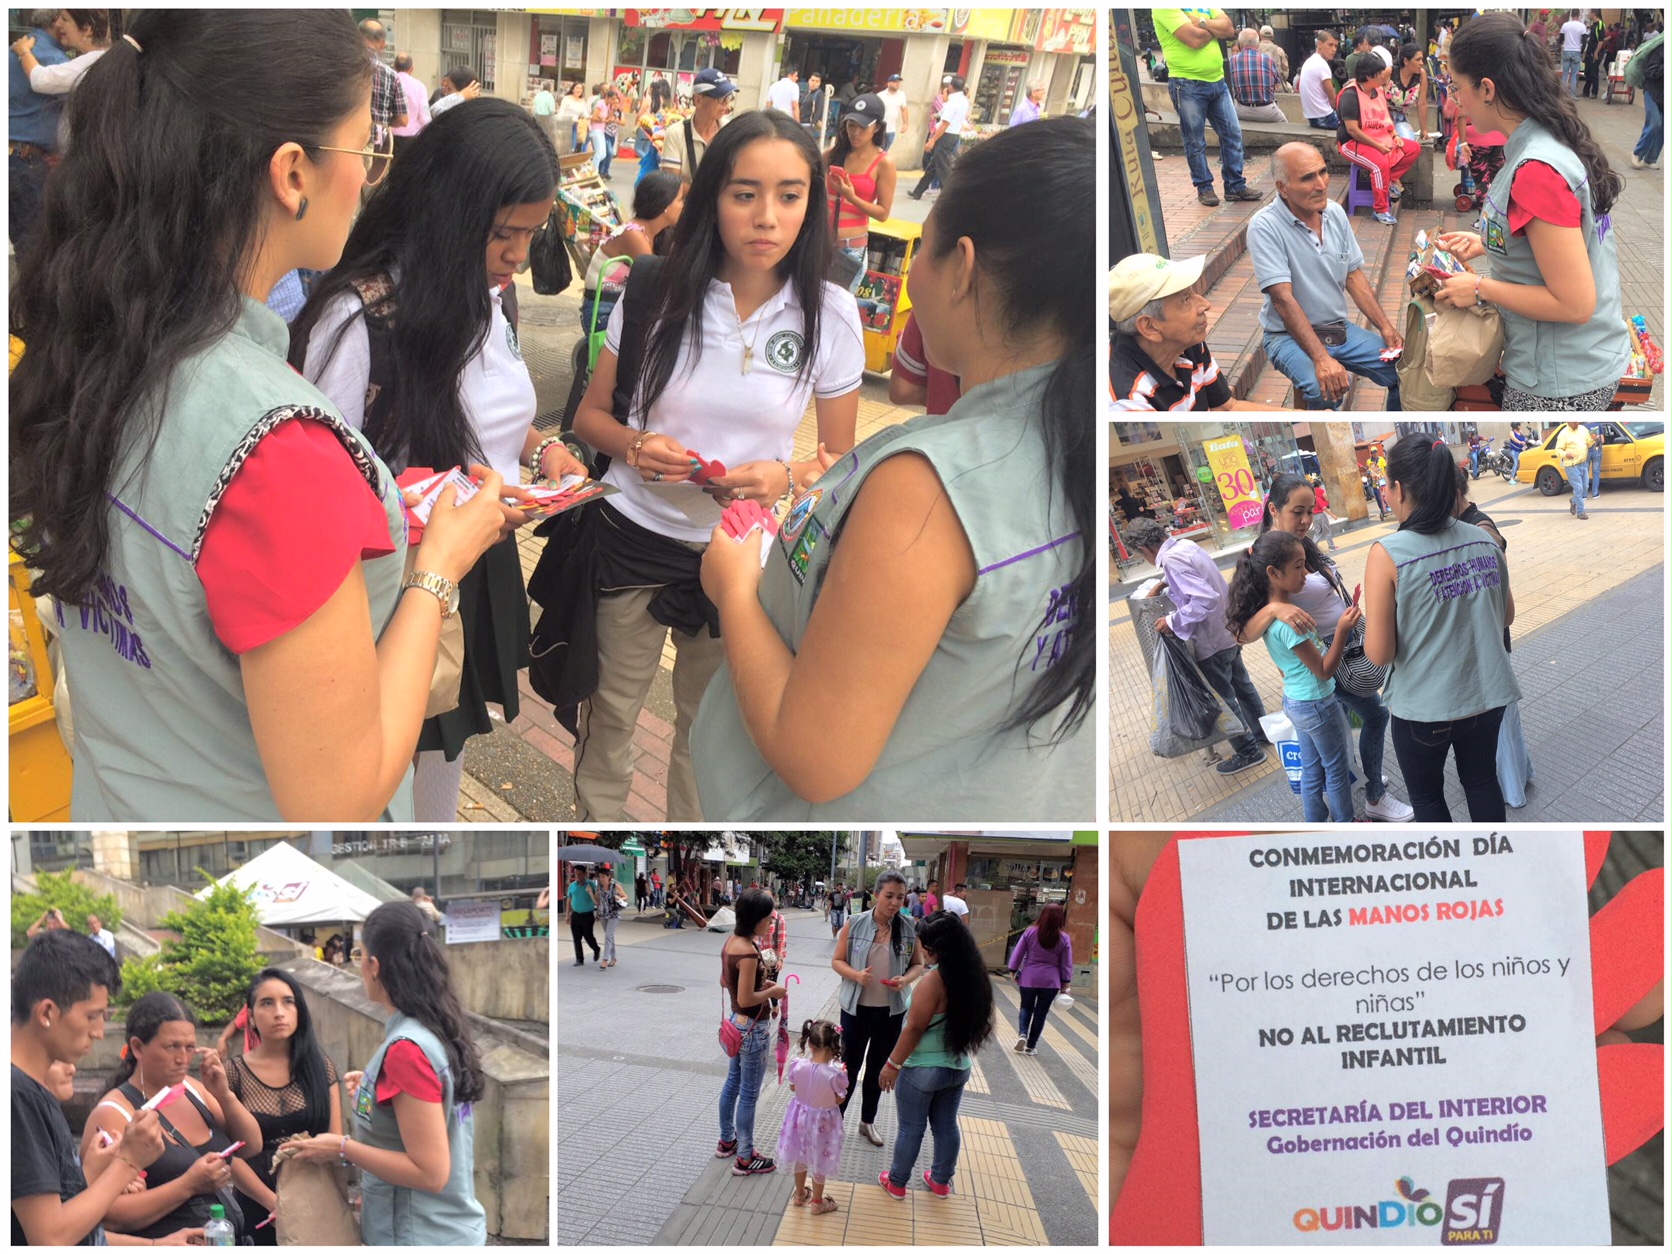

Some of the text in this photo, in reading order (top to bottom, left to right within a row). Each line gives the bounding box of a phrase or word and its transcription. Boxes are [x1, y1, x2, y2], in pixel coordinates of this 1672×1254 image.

[1242, 506, 1261, 522] par
[1429, 562, 1469, 586] DERECHOS
[1249, 834, 1513, 868] CONMEMORACIÓN DÍA
[1289, 870, 1478, 897] INTERNACIONAL
[1267, 899, 1504, 930] DE LAS MANOS ROJAS
[1265, 971, 1293, 990] los
[1302, 965, 1409, 988] derechos
[1417, 961, 1447, 981] de
[1456, 960, 1484, 979] los
[1493, 956, 1550, 976] niños
[1558, 958, 1570, 977] y
[1259, 1014, 1526, 1047] NO AL RECLUTAMIENTO
[1341, 1046, 1446, 1069] INFANTIL
[1249, 1095, 1547, 1128] SECRETARÍA DEL INTERIOR
[1267, 1123, 1532, 1154] Gobernación del Quindío
[1448, 1230, 1493, 1241] PARA TI
